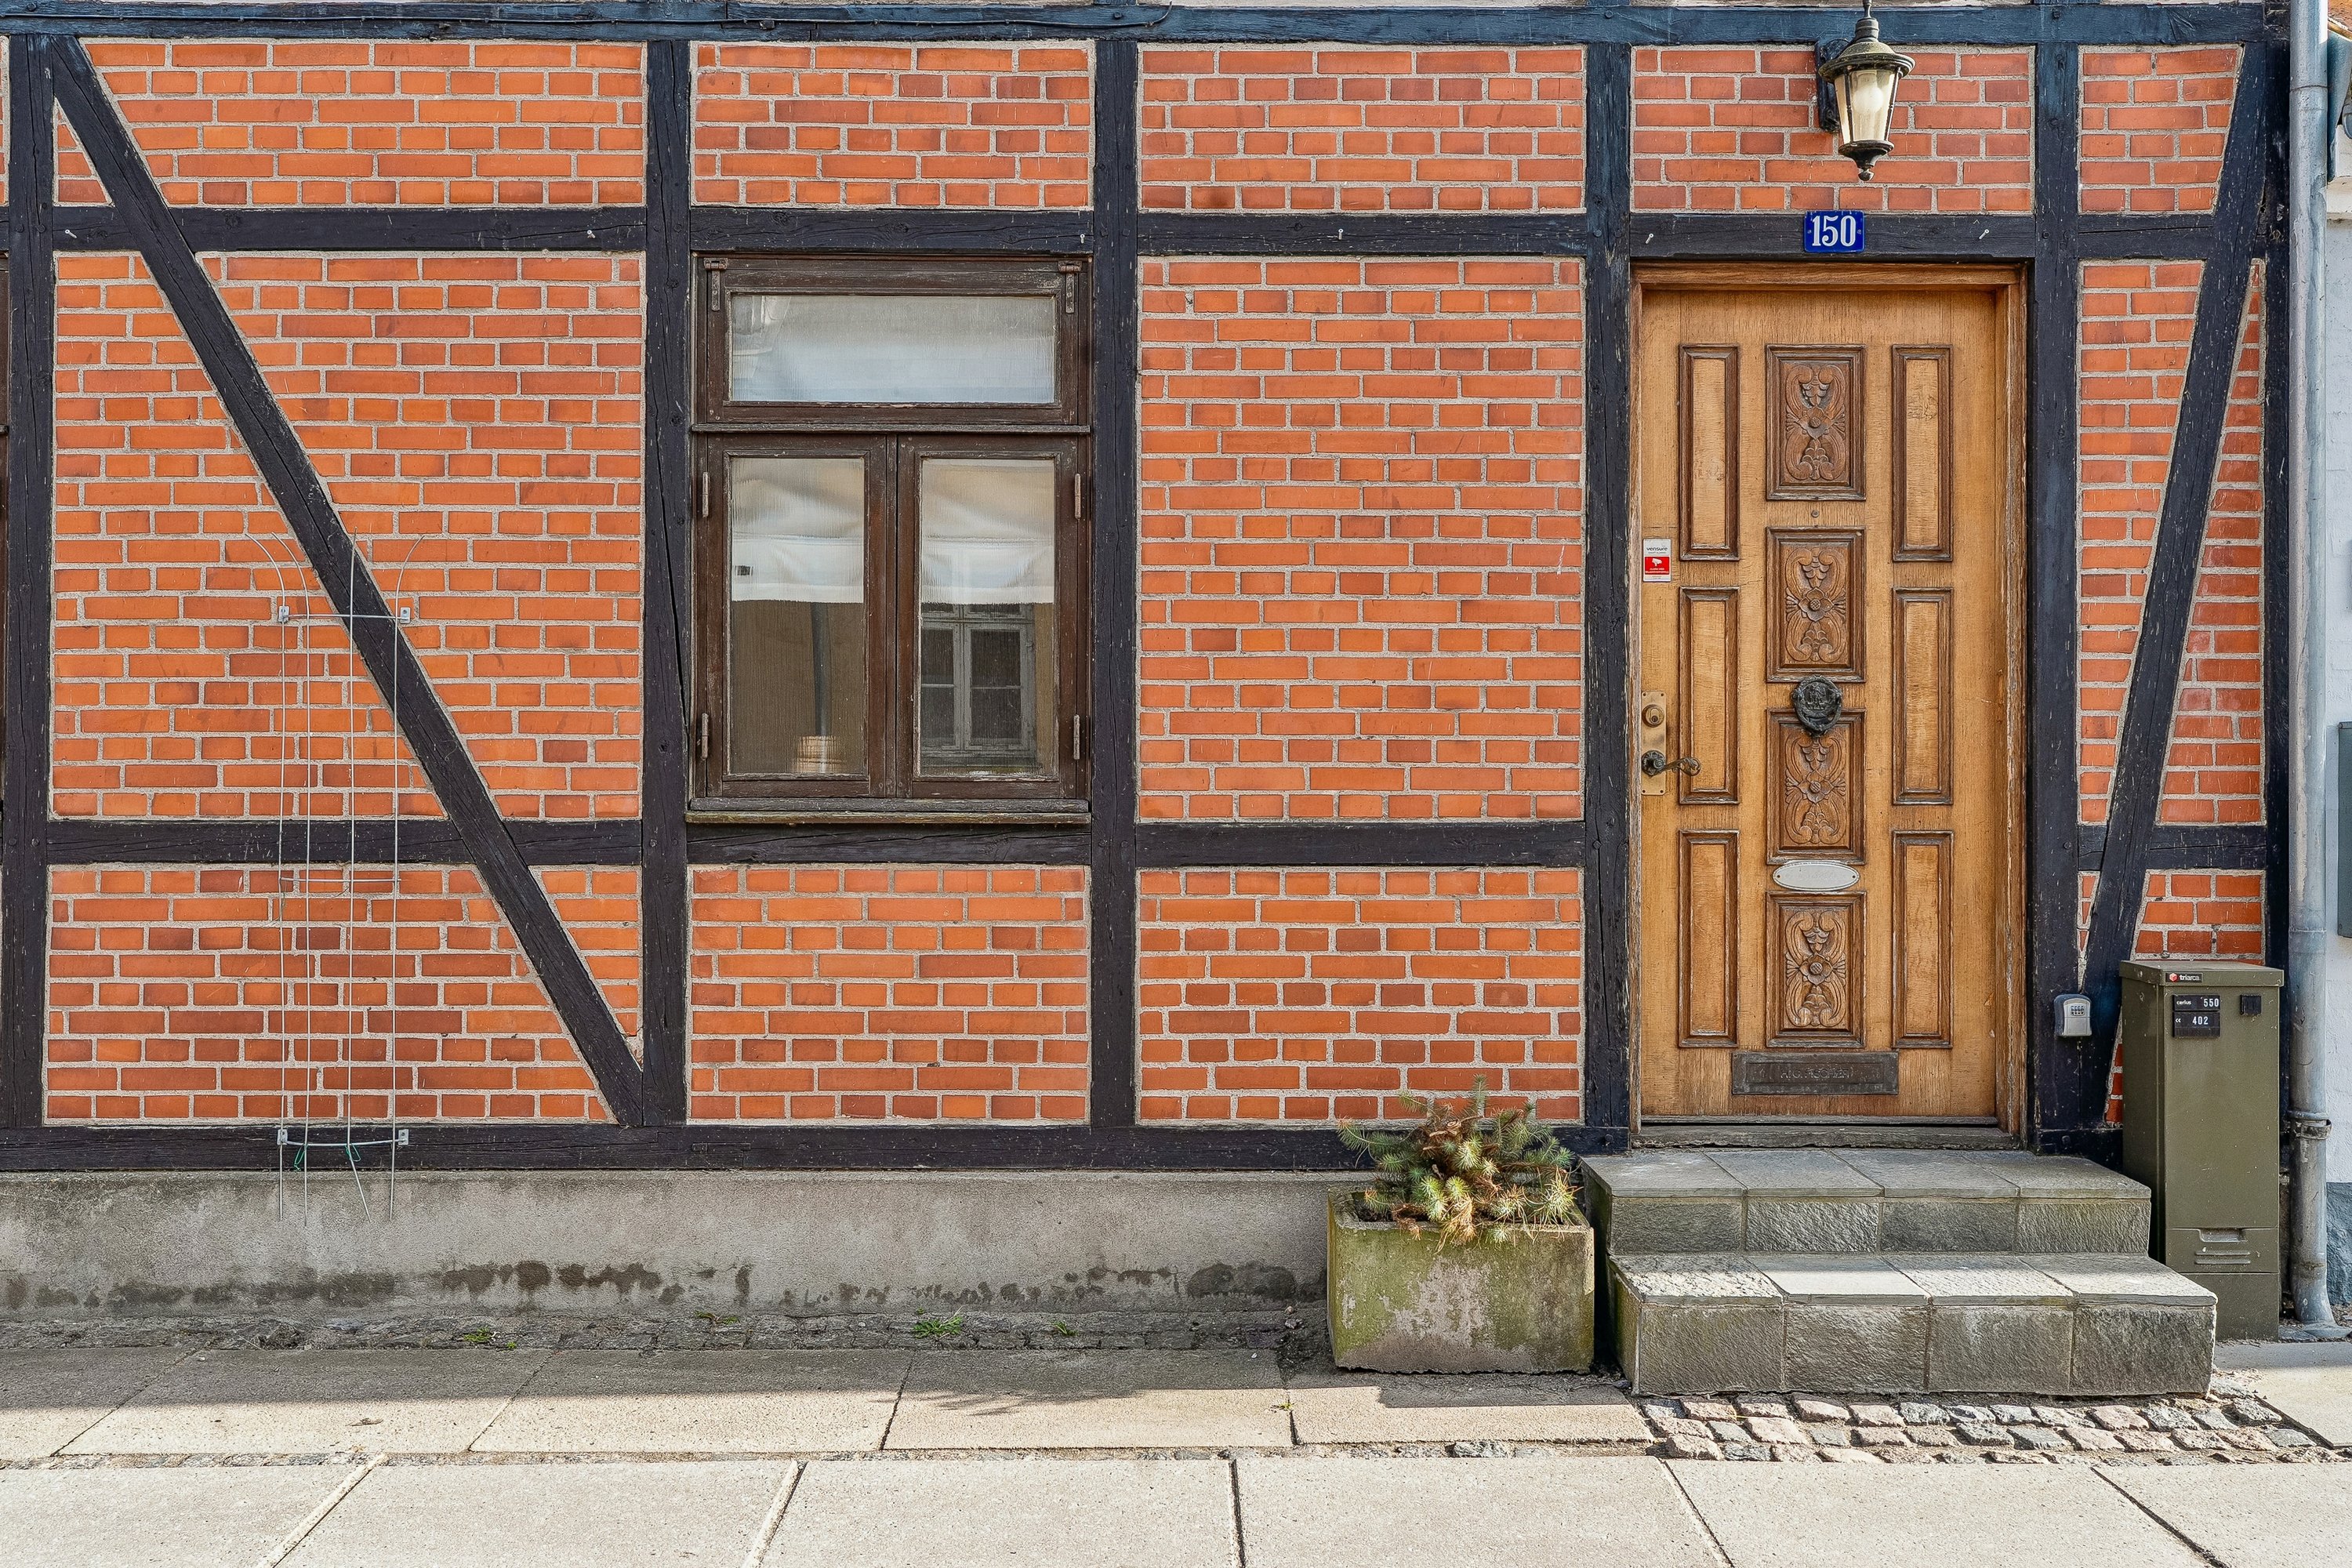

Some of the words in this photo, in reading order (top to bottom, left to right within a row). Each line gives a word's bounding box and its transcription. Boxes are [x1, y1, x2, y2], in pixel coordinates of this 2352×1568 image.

[1812, 215, 1856, 247] 150
[2203, 998, 2220, 1007] 550
[2192, 1015, 2209, 1025] 402
